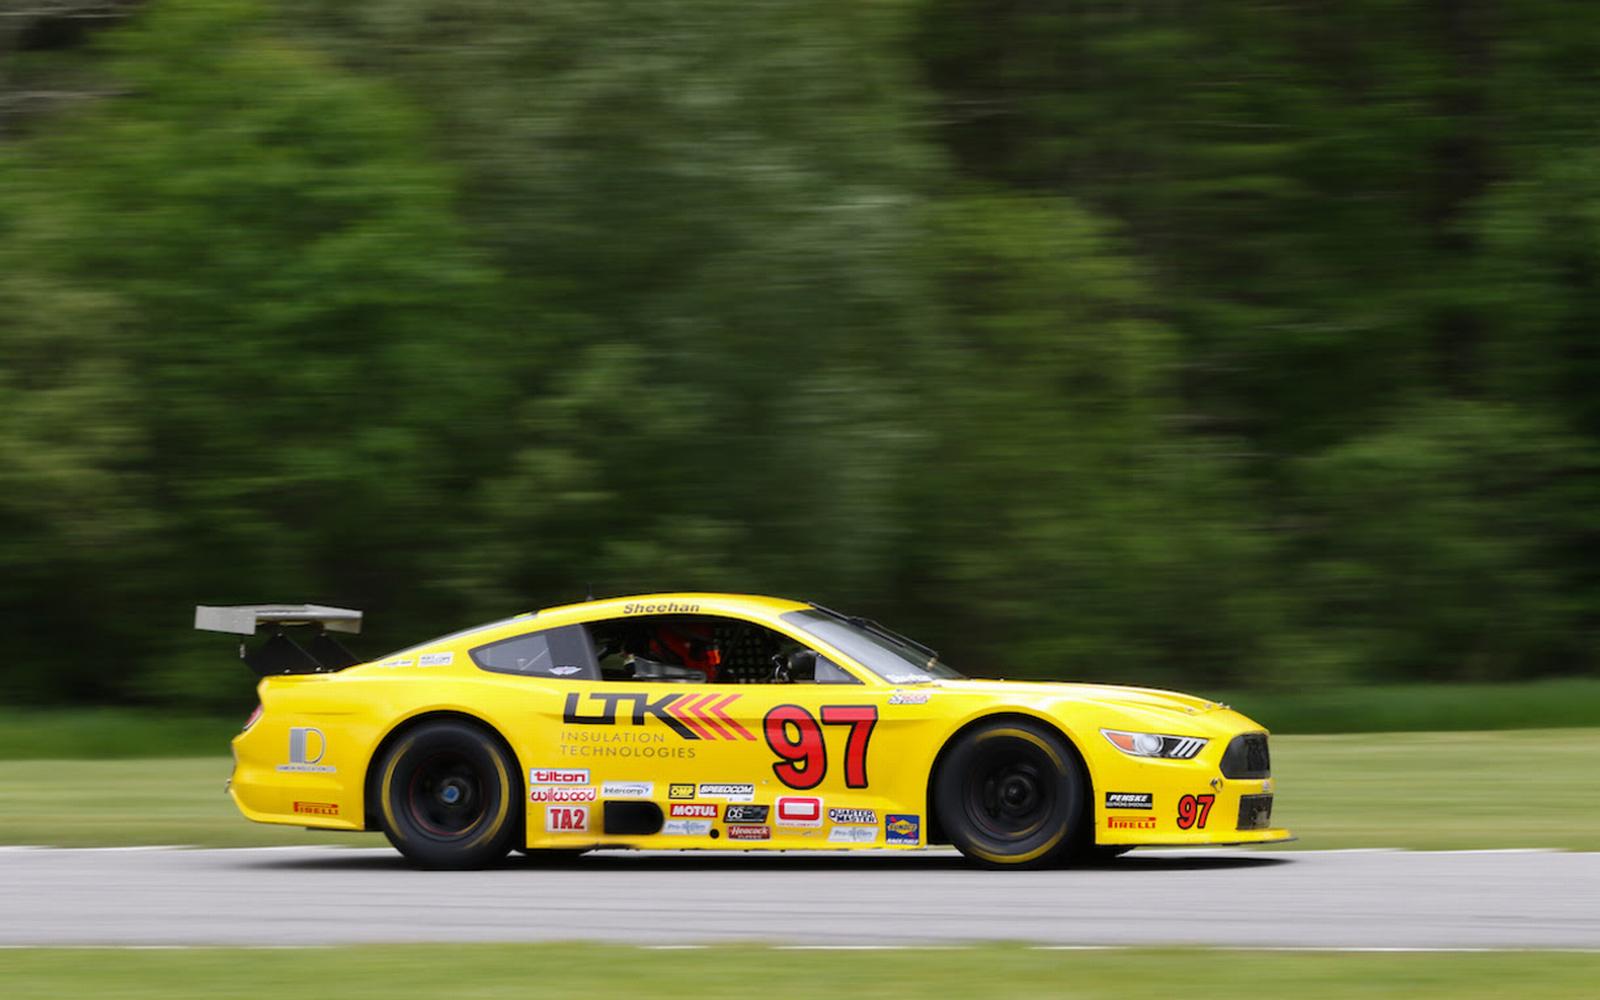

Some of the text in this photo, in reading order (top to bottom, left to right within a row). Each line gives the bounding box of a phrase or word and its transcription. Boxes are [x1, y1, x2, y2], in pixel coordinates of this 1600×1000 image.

[624, 603, 700, 614] Sheehan
[563, 692, 702, 740] LTK
[560, 732, 665, 742] INSULATION
[560, 745, 696, 758] TECHNOLOGIES
[762, 704, 879, 790] 97
[534, 771, 586, 782] tilton
[530, 788, 597, 801] wilwood
[293, 801, 339, 815] PIRELLI
[672, 805, 717, 816] MOTUL
[828, 808, 874, 818] QUARTER
[1177, 794, 1216, 830] 97
[550, 808, 585, 829] TA2
[836, 815, 875, 823] MASTER
[1107, 817, 1156, 828] PIRELLI
